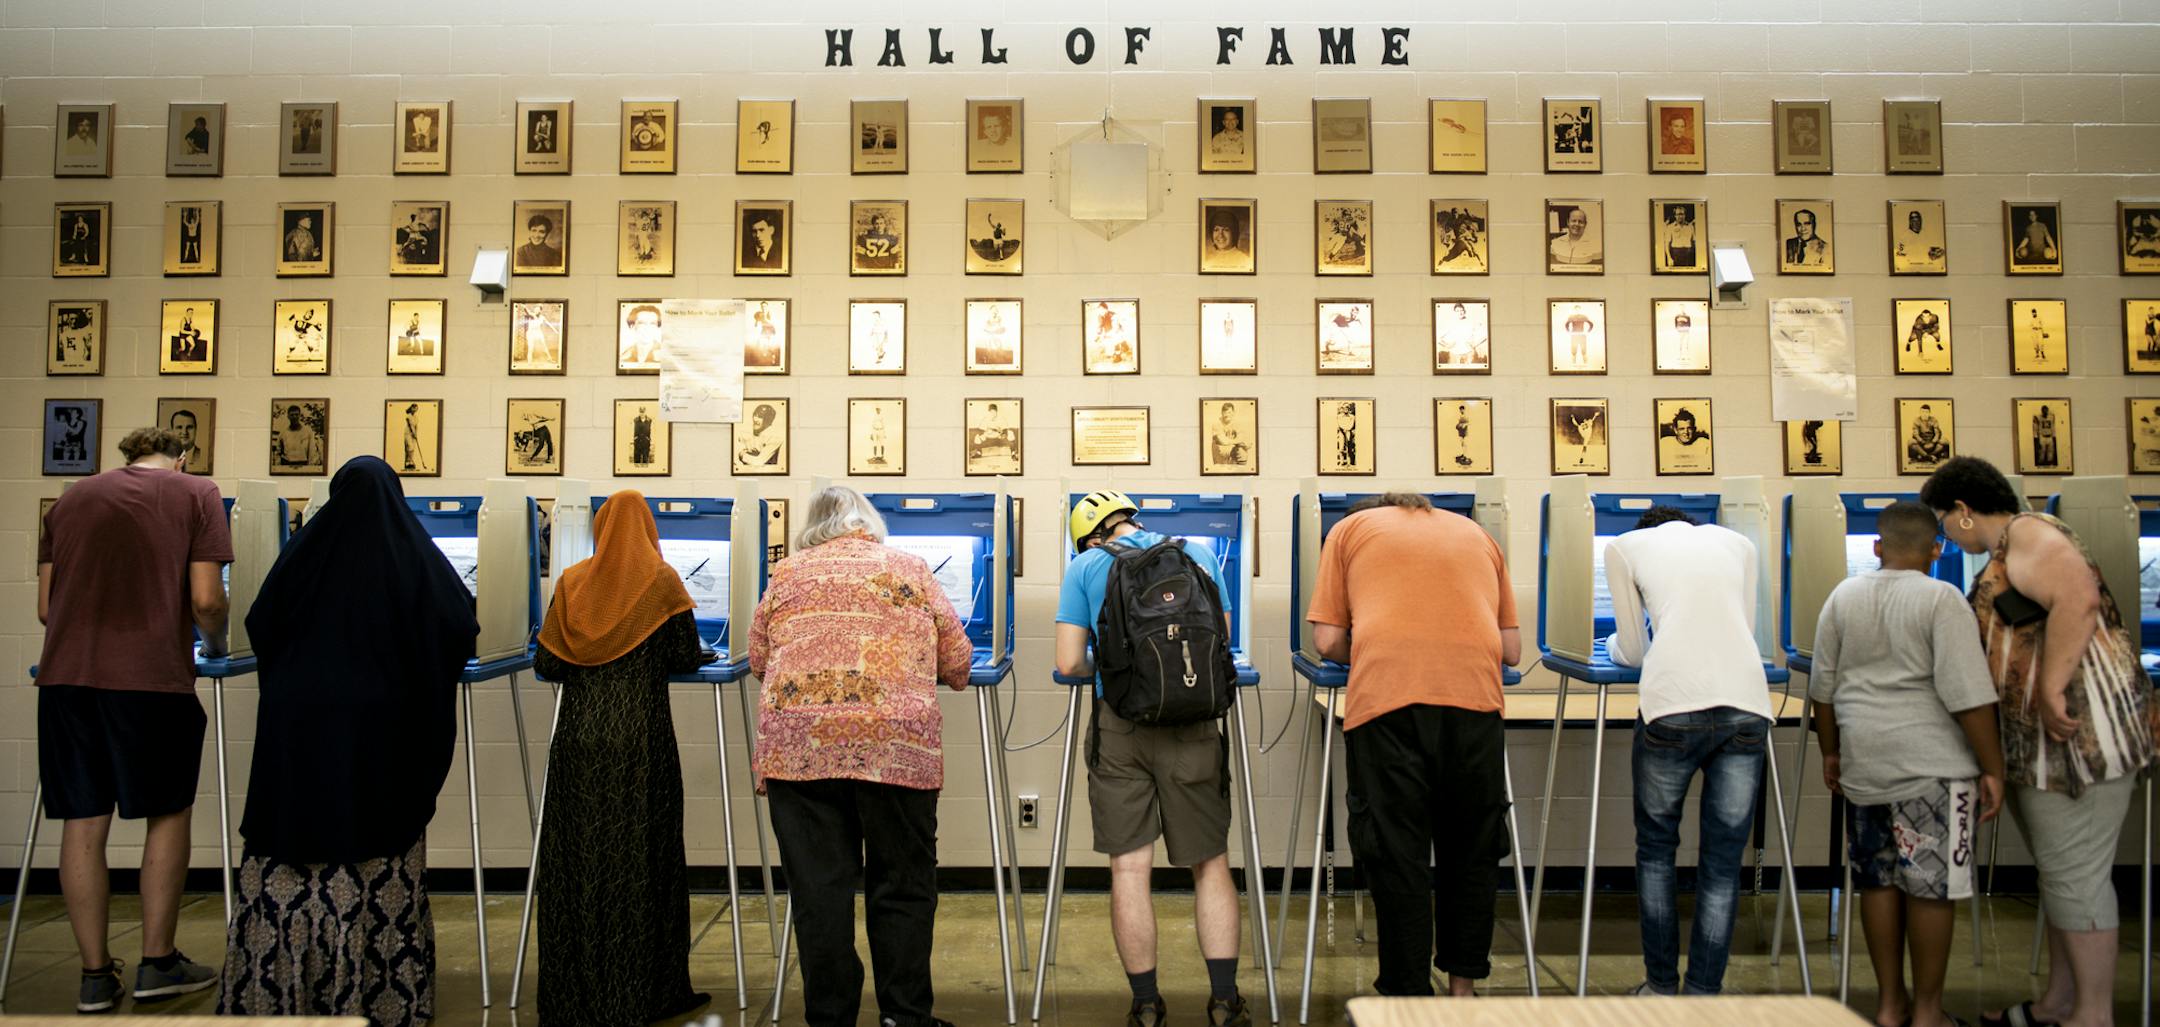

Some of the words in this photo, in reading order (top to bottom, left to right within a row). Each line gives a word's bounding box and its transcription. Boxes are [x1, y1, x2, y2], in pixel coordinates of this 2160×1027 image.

[825, 28, 1008, 67] HALL
[1065, 27, 1151, 65] OF
[1216, 27, 1410, 66] FAME
[866, 238, 890, 257] 52
